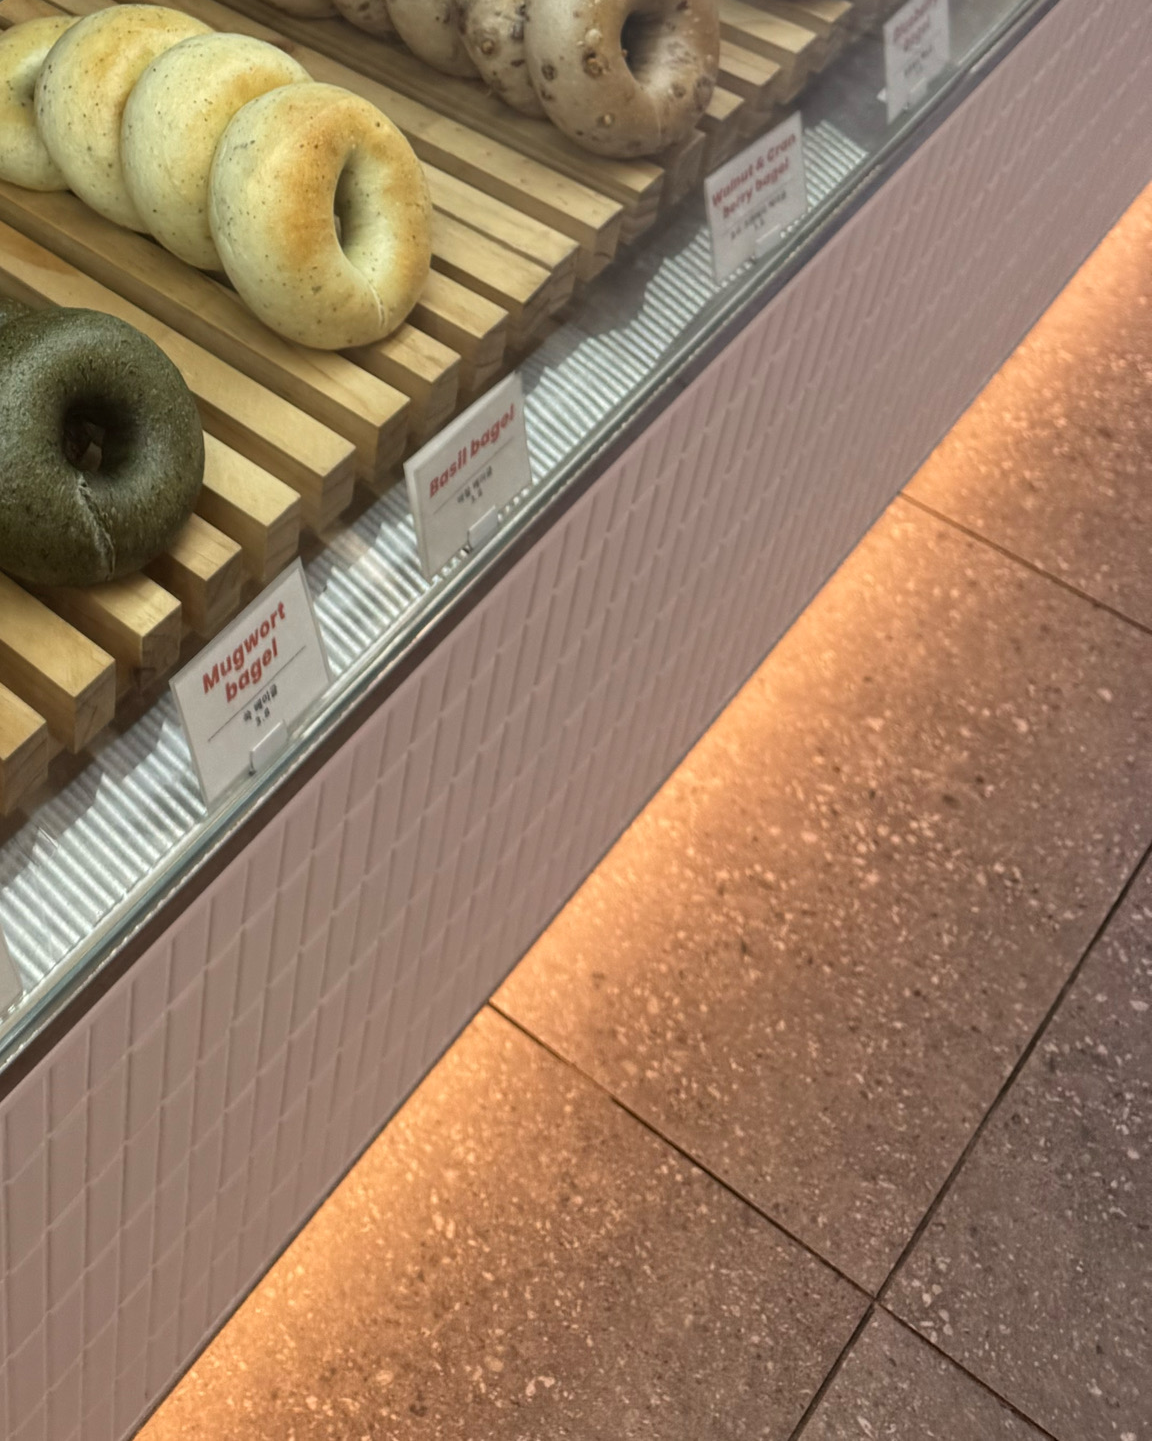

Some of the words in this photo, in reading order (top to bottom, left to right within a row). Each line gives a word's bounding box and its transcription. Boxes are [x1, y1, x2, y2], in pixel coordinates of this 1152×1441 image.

[429, 446, 468, 499] Basil
[470, 403, 515, 459] bagel
[202, 601, 286, 695] Mugwort
[224, 639, 279, 704] bagel
